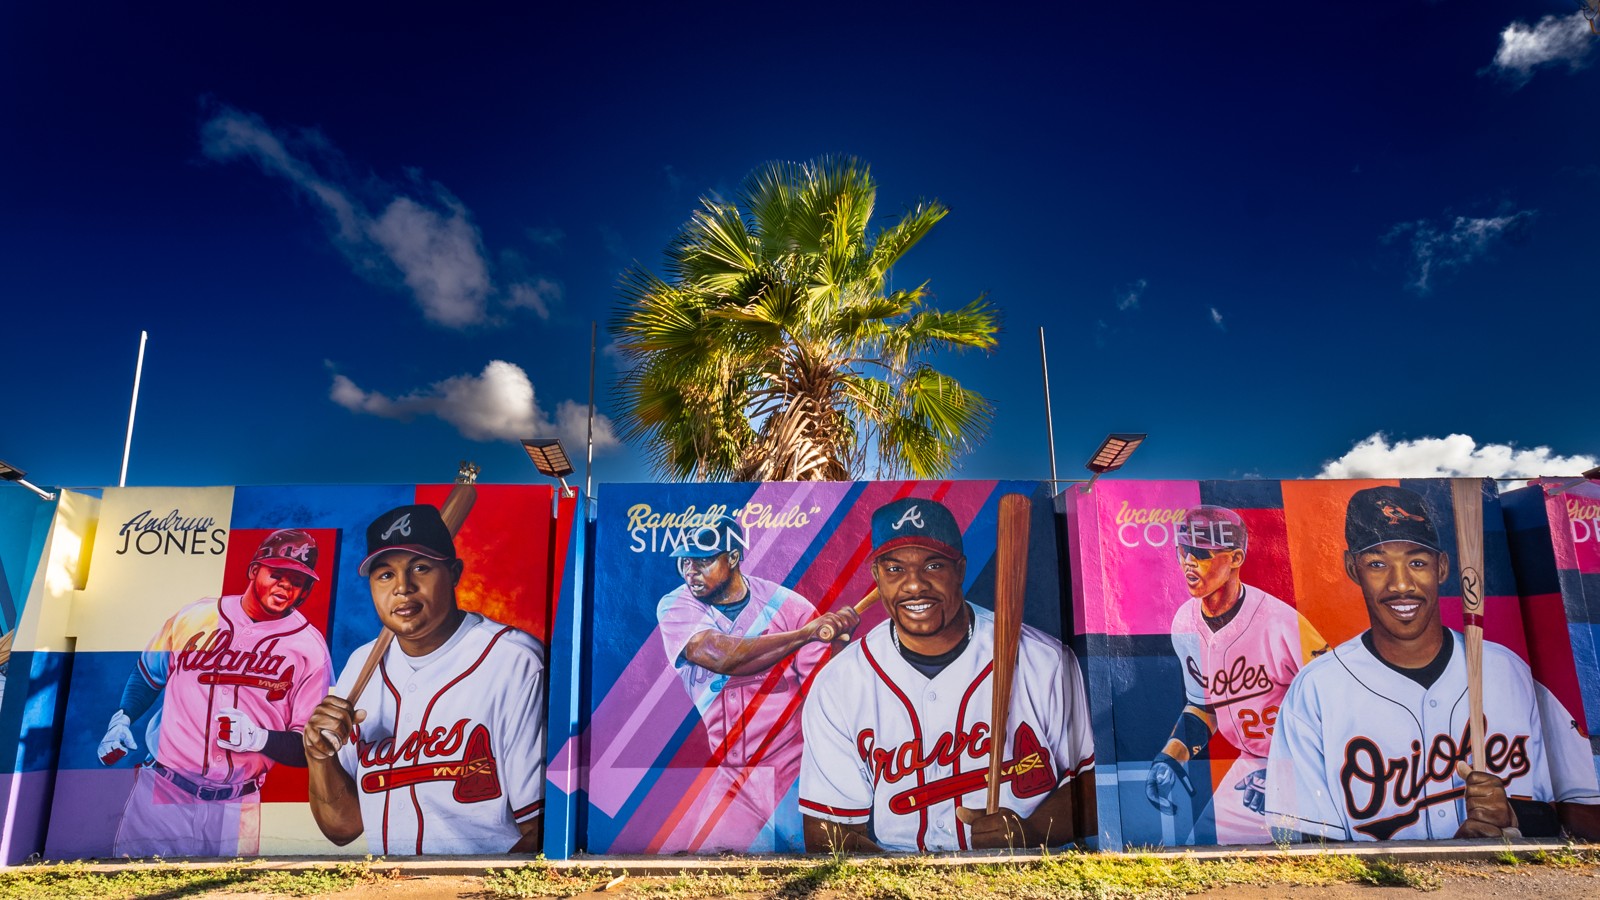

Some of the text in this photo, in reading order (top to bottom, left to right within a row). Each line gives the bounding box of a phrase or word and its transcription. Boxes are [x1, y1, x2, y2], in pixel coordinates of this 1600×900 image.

[119, 508, 215, 536] Andruw
[627, 503, 727, 532] Randall
[115, 528, 226, 555] JONES
[629, 526, 750, 553] SIMON
[1117, 520, 1235, 548] COFFIE
[176, 628, 286, 675] Atlanta
[350, 718, 472, 768] raves
